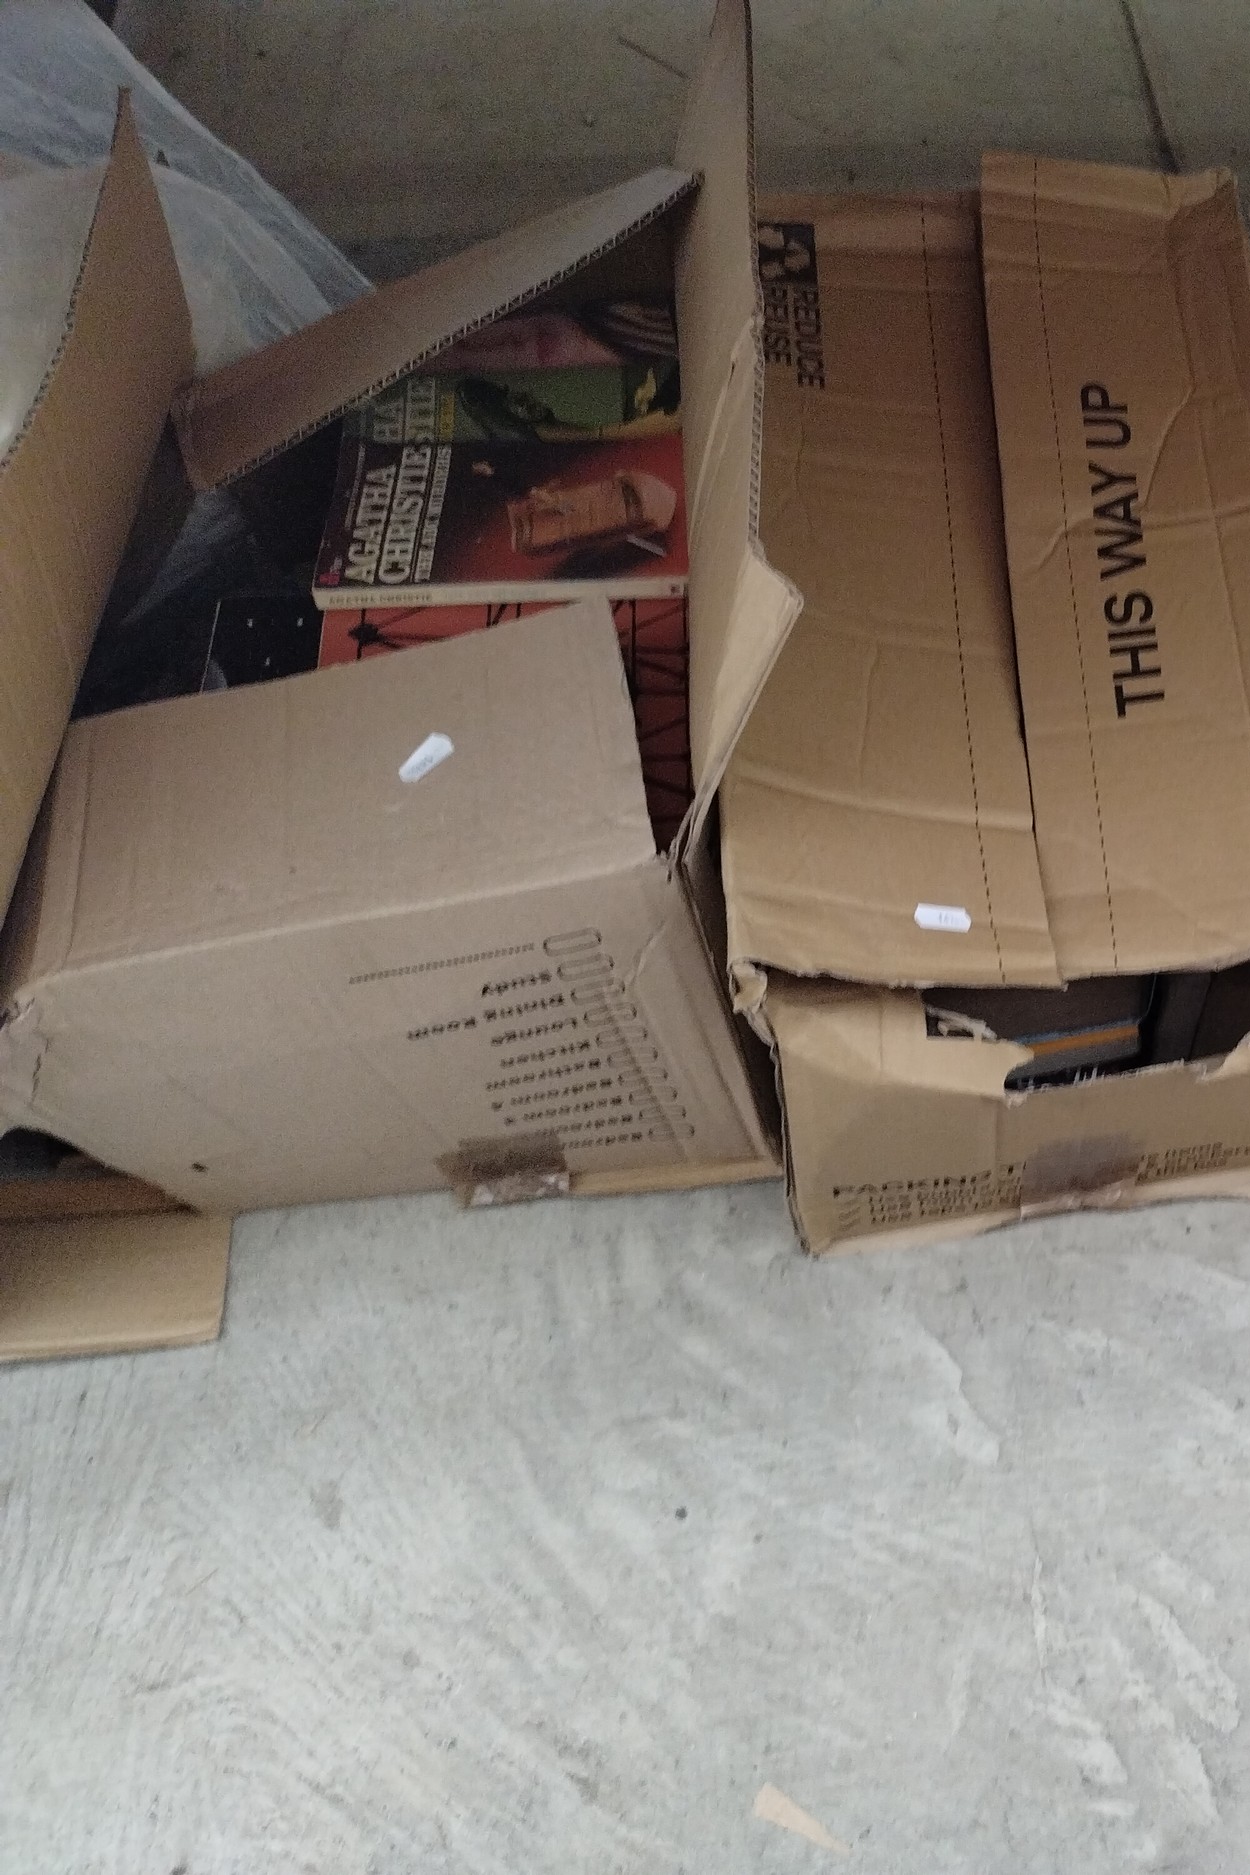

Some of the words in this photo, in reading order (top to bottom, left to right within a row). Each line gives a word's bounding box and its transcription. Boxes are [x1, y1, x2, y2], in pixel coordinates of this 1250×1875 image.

[794, 288, 825, 389] REDUCE
[1080, 382, 1131, 449] UP
[345, 464, 397, 584] AGATHA
[378, 447, 431, 585] CHRISTIE
[1089, 460, 1146, 581] WAY
[1104, 590, 1165, 718] THIS
[407, 1015, 477, 1041] Room
[482, 969, 552, 998] Study
[500, 1040, 590, 1068] Kitchen
